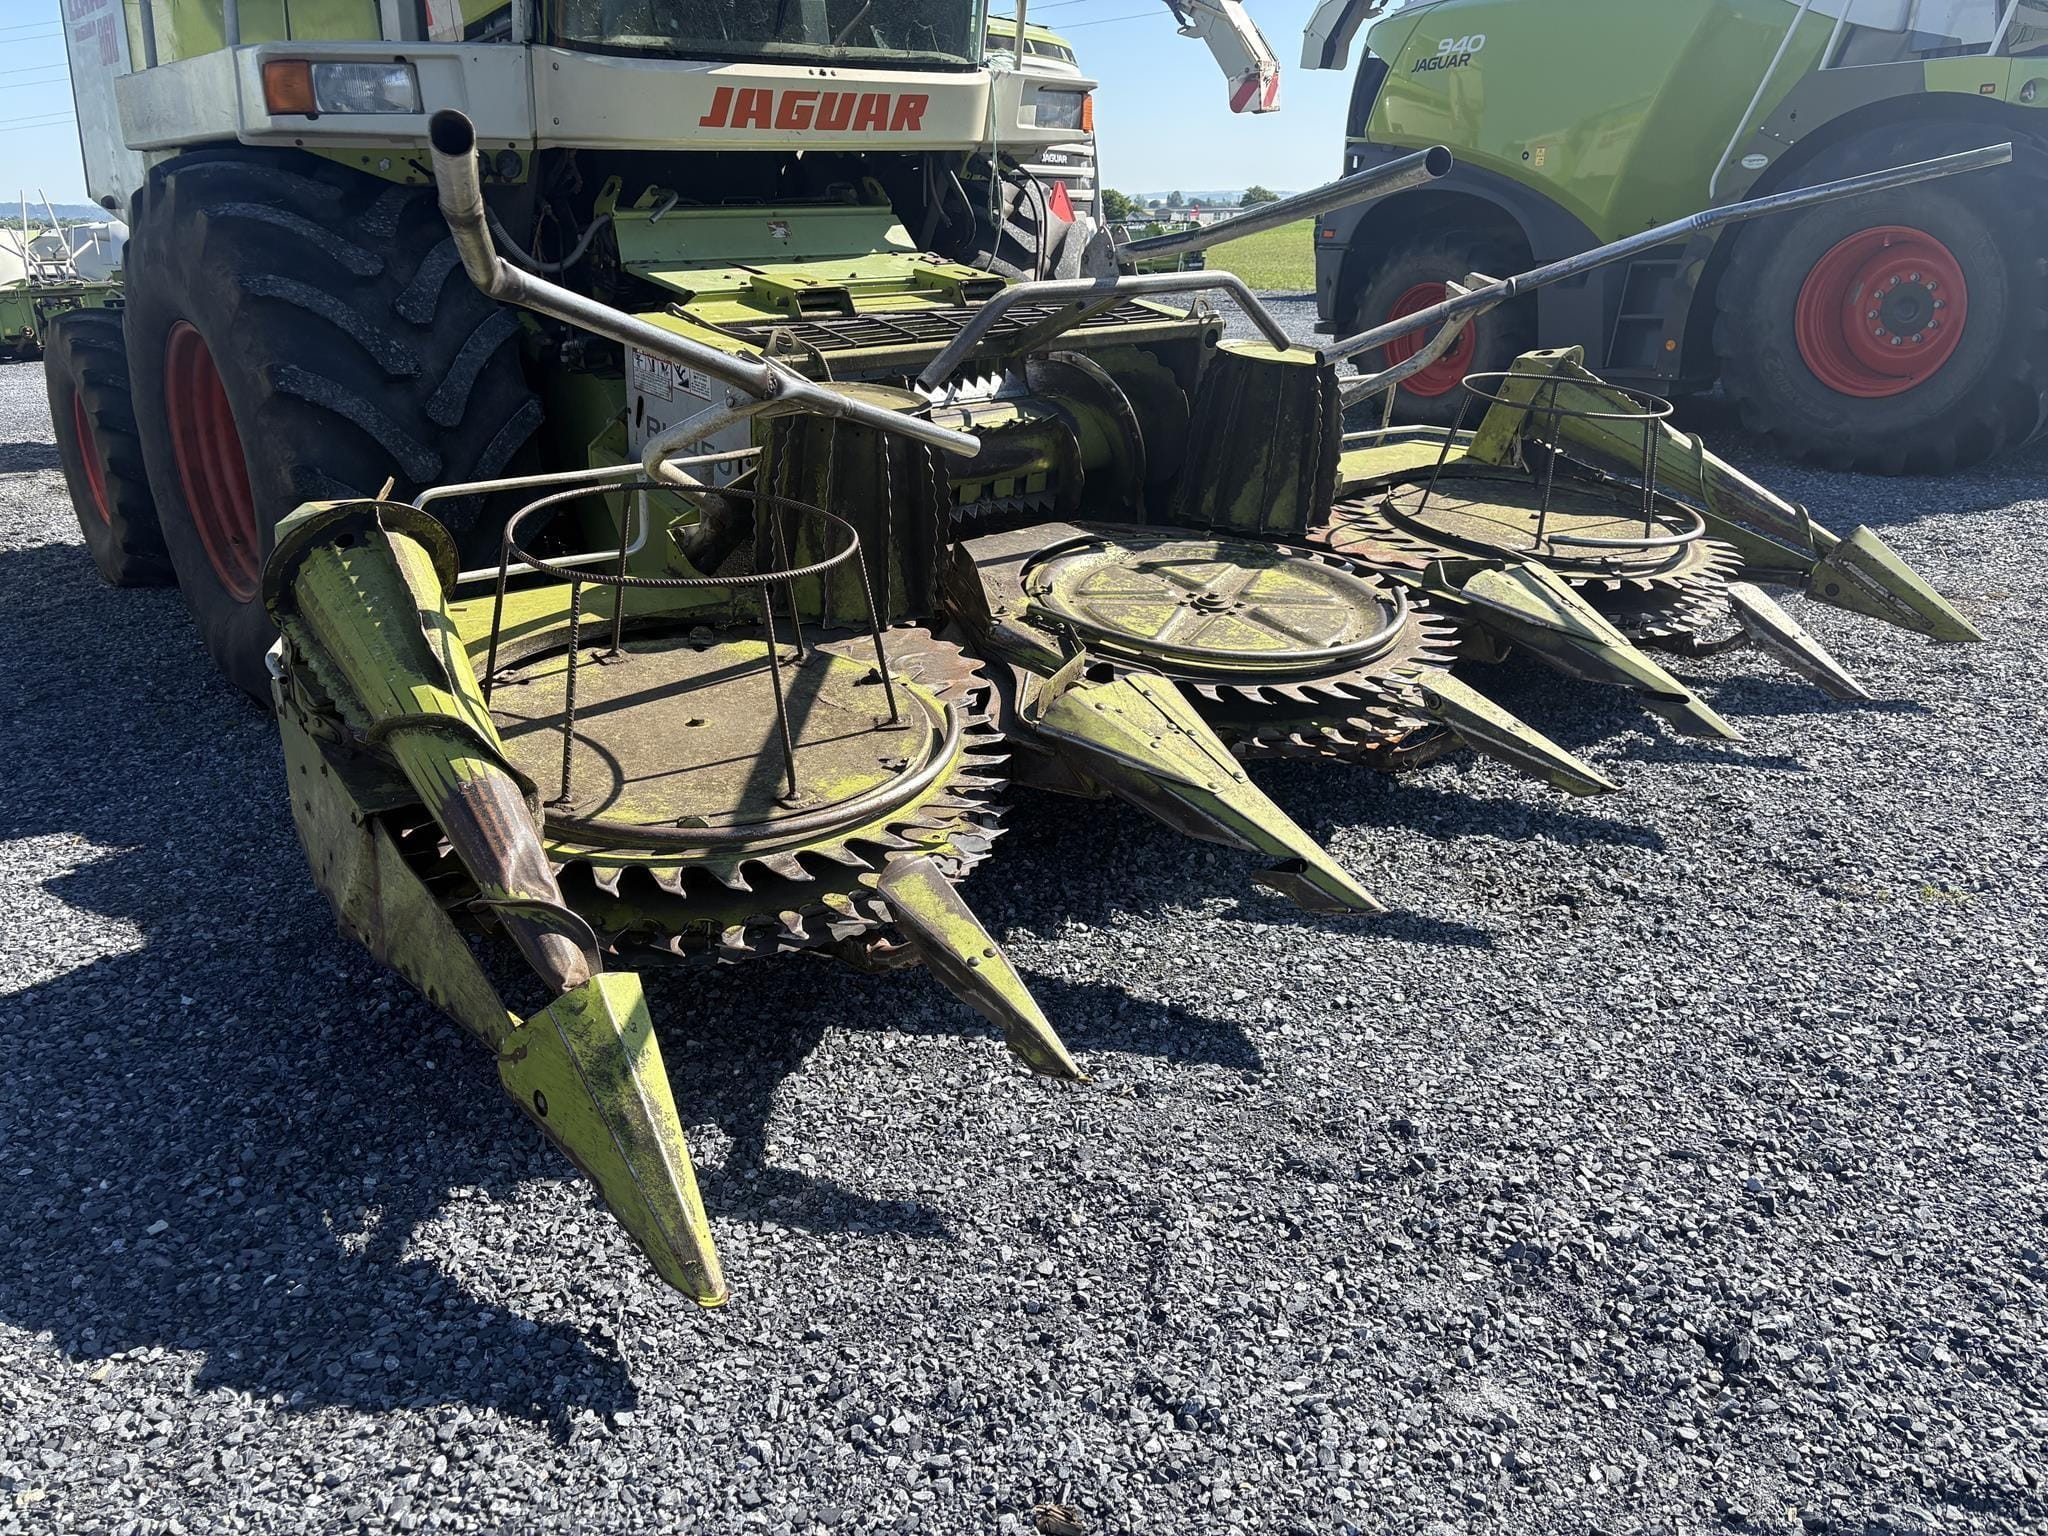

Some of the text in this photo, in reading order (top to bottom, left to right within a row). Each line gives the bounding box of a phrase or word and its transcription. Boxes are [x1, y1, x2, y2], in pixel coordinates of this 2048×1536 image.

[1436, 34, 1486, 56] 940
[1411, 53, 1471, 73] JAGUAR
[699, 87, 929, 131] JAGUAR
[1041, 153, 1068, 164] JAGUAR
